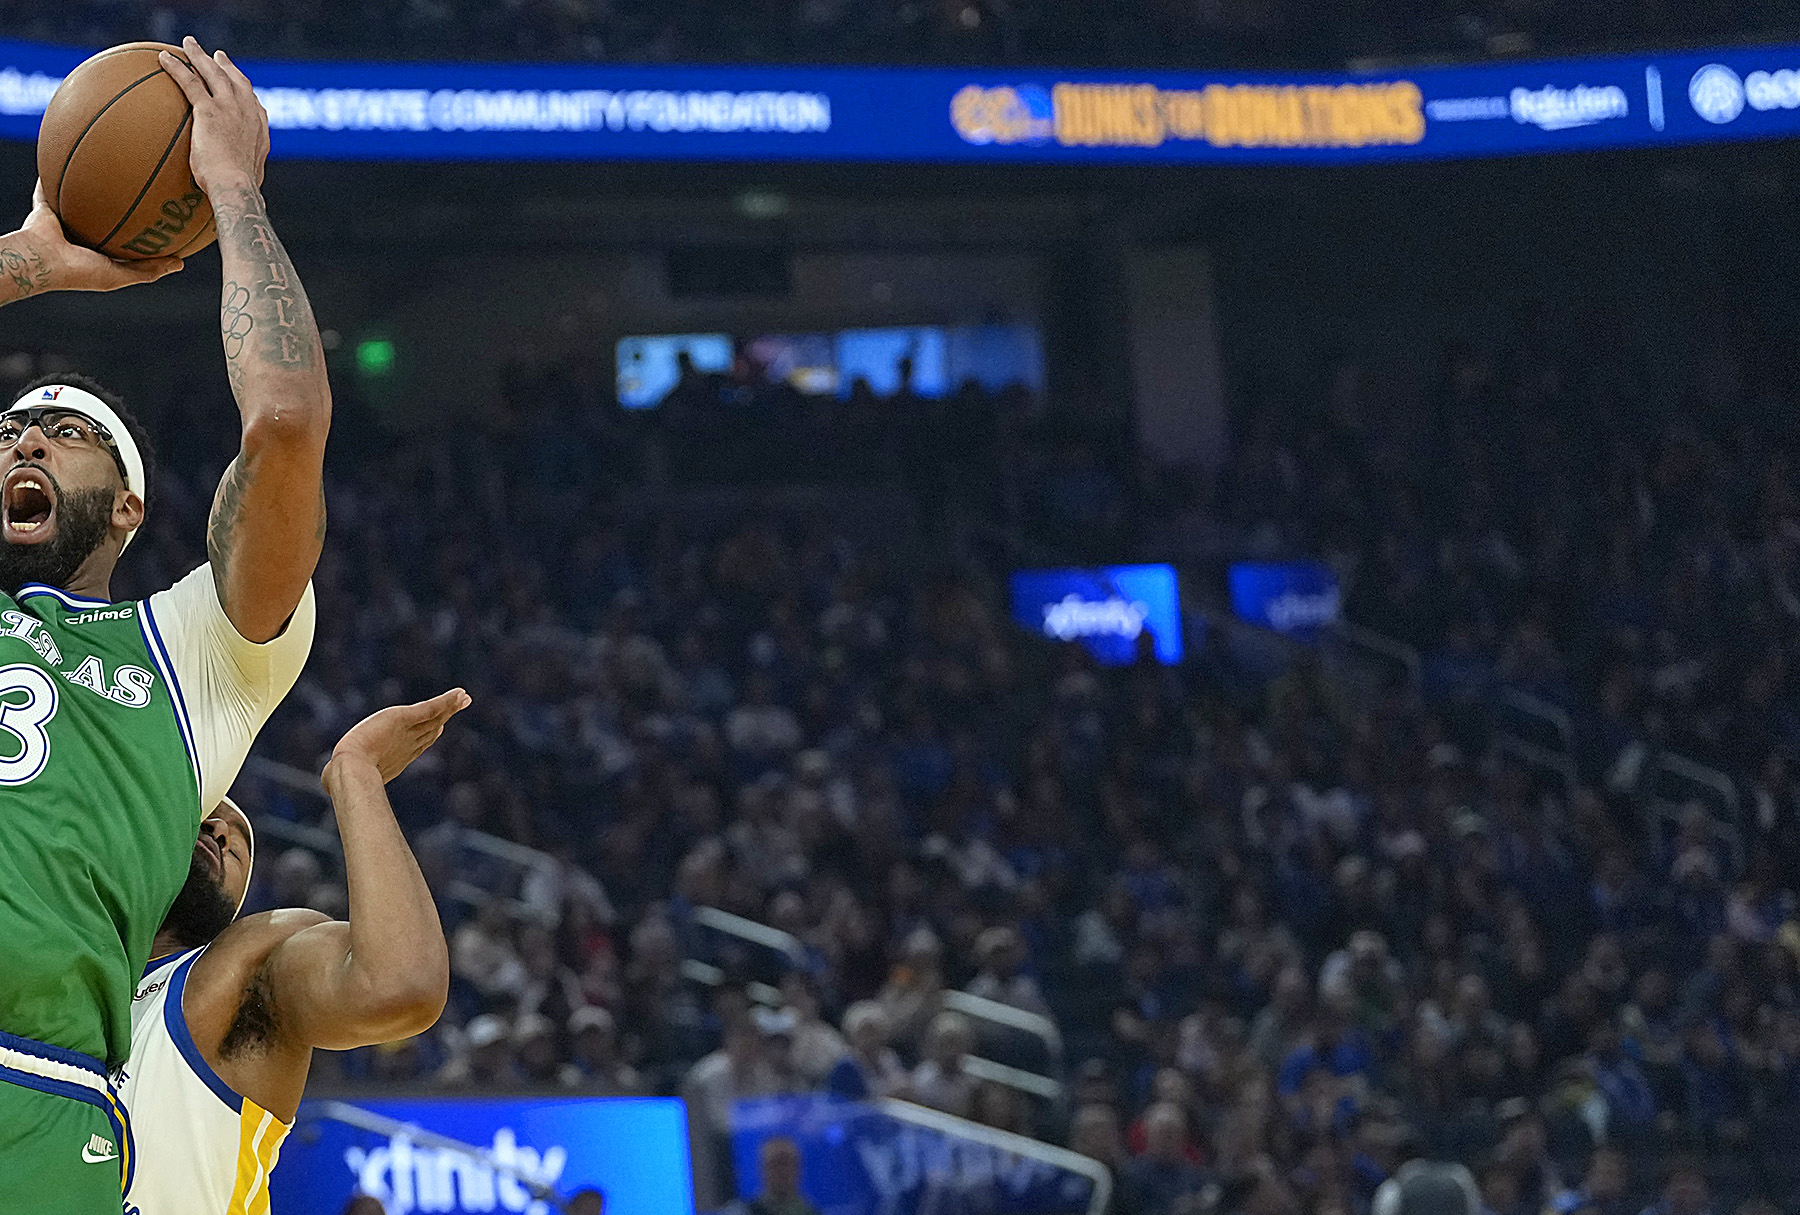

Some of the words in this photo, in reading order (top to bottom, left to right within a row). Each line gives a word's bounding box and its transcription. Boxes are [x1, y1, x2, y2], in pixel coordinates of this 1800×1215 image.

[120, 176, 205, 255] Wils
[64, 607, 133, 625] chime
[88, 1133, 113, 1157] NIKE
